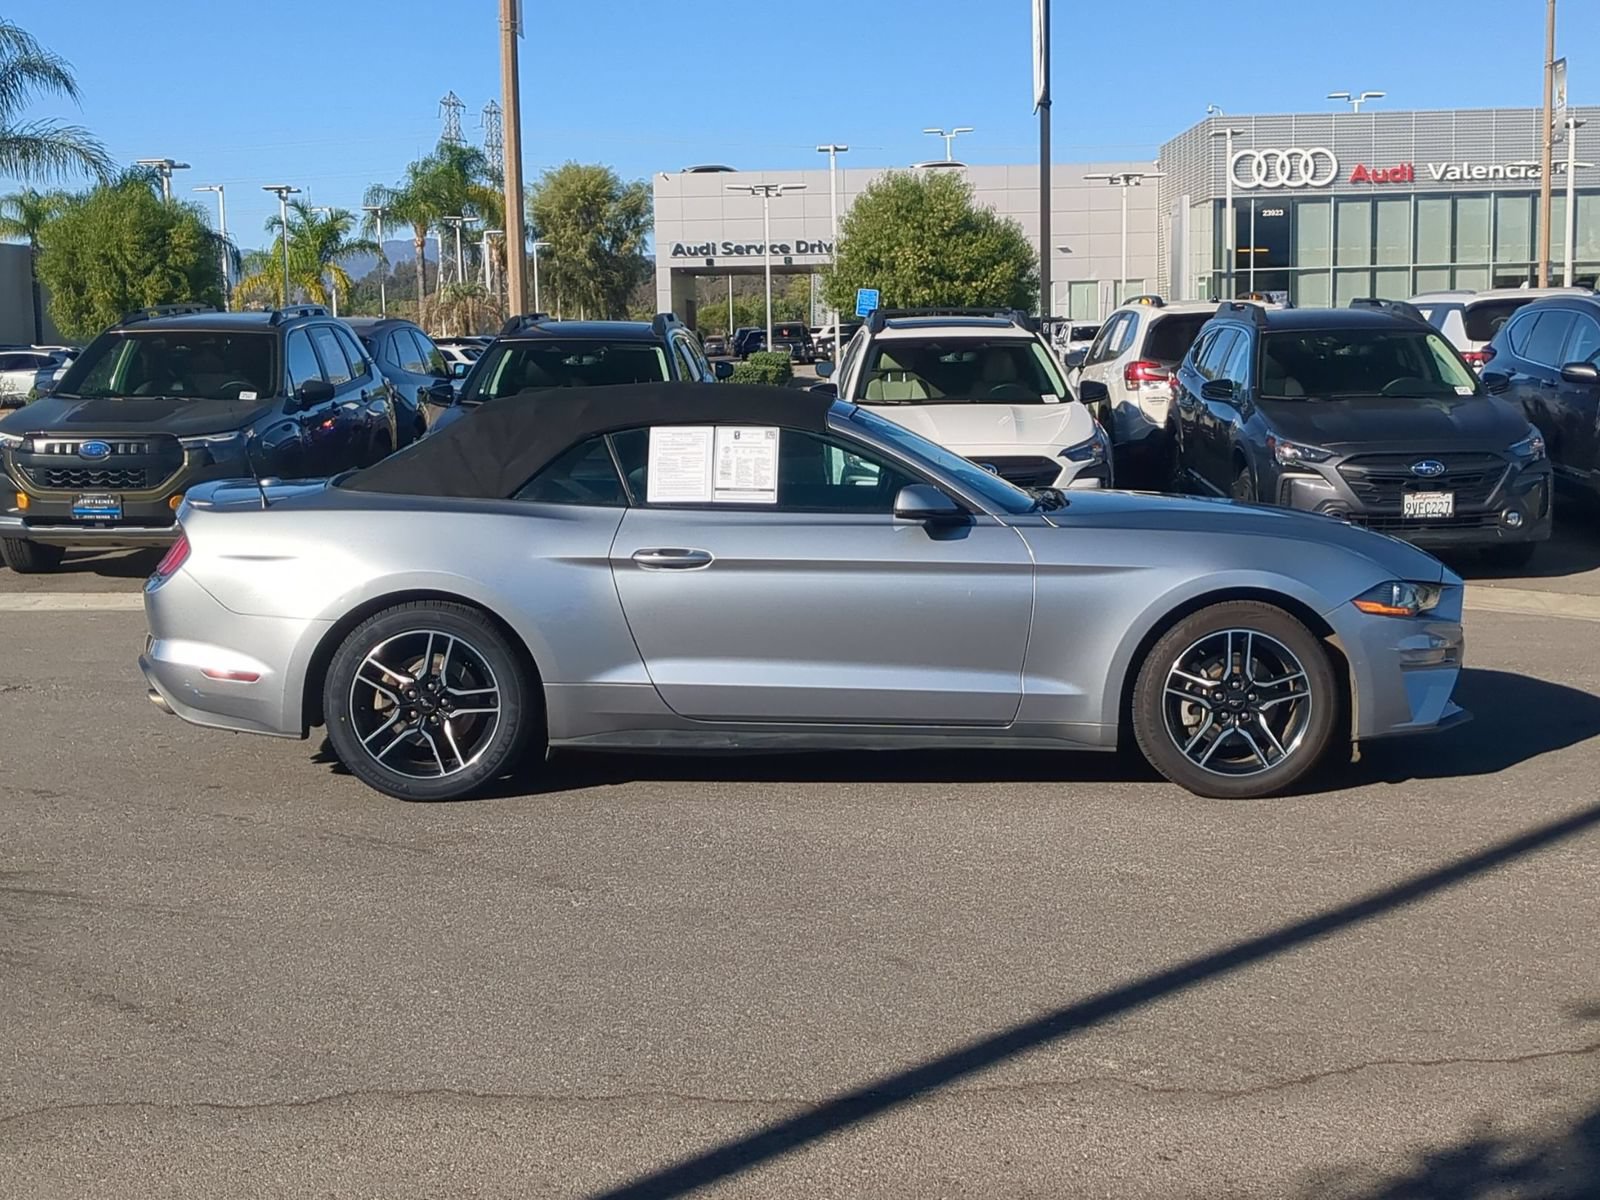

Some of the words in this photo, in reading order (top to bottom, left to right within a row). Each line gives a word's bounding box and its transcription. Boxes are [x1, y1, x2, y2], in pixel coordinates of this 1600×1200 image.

[1349, 162, 1415, 184] Audi
[671, 242, 717, 257] Audi
[795, 239, 833, 254] Driv
